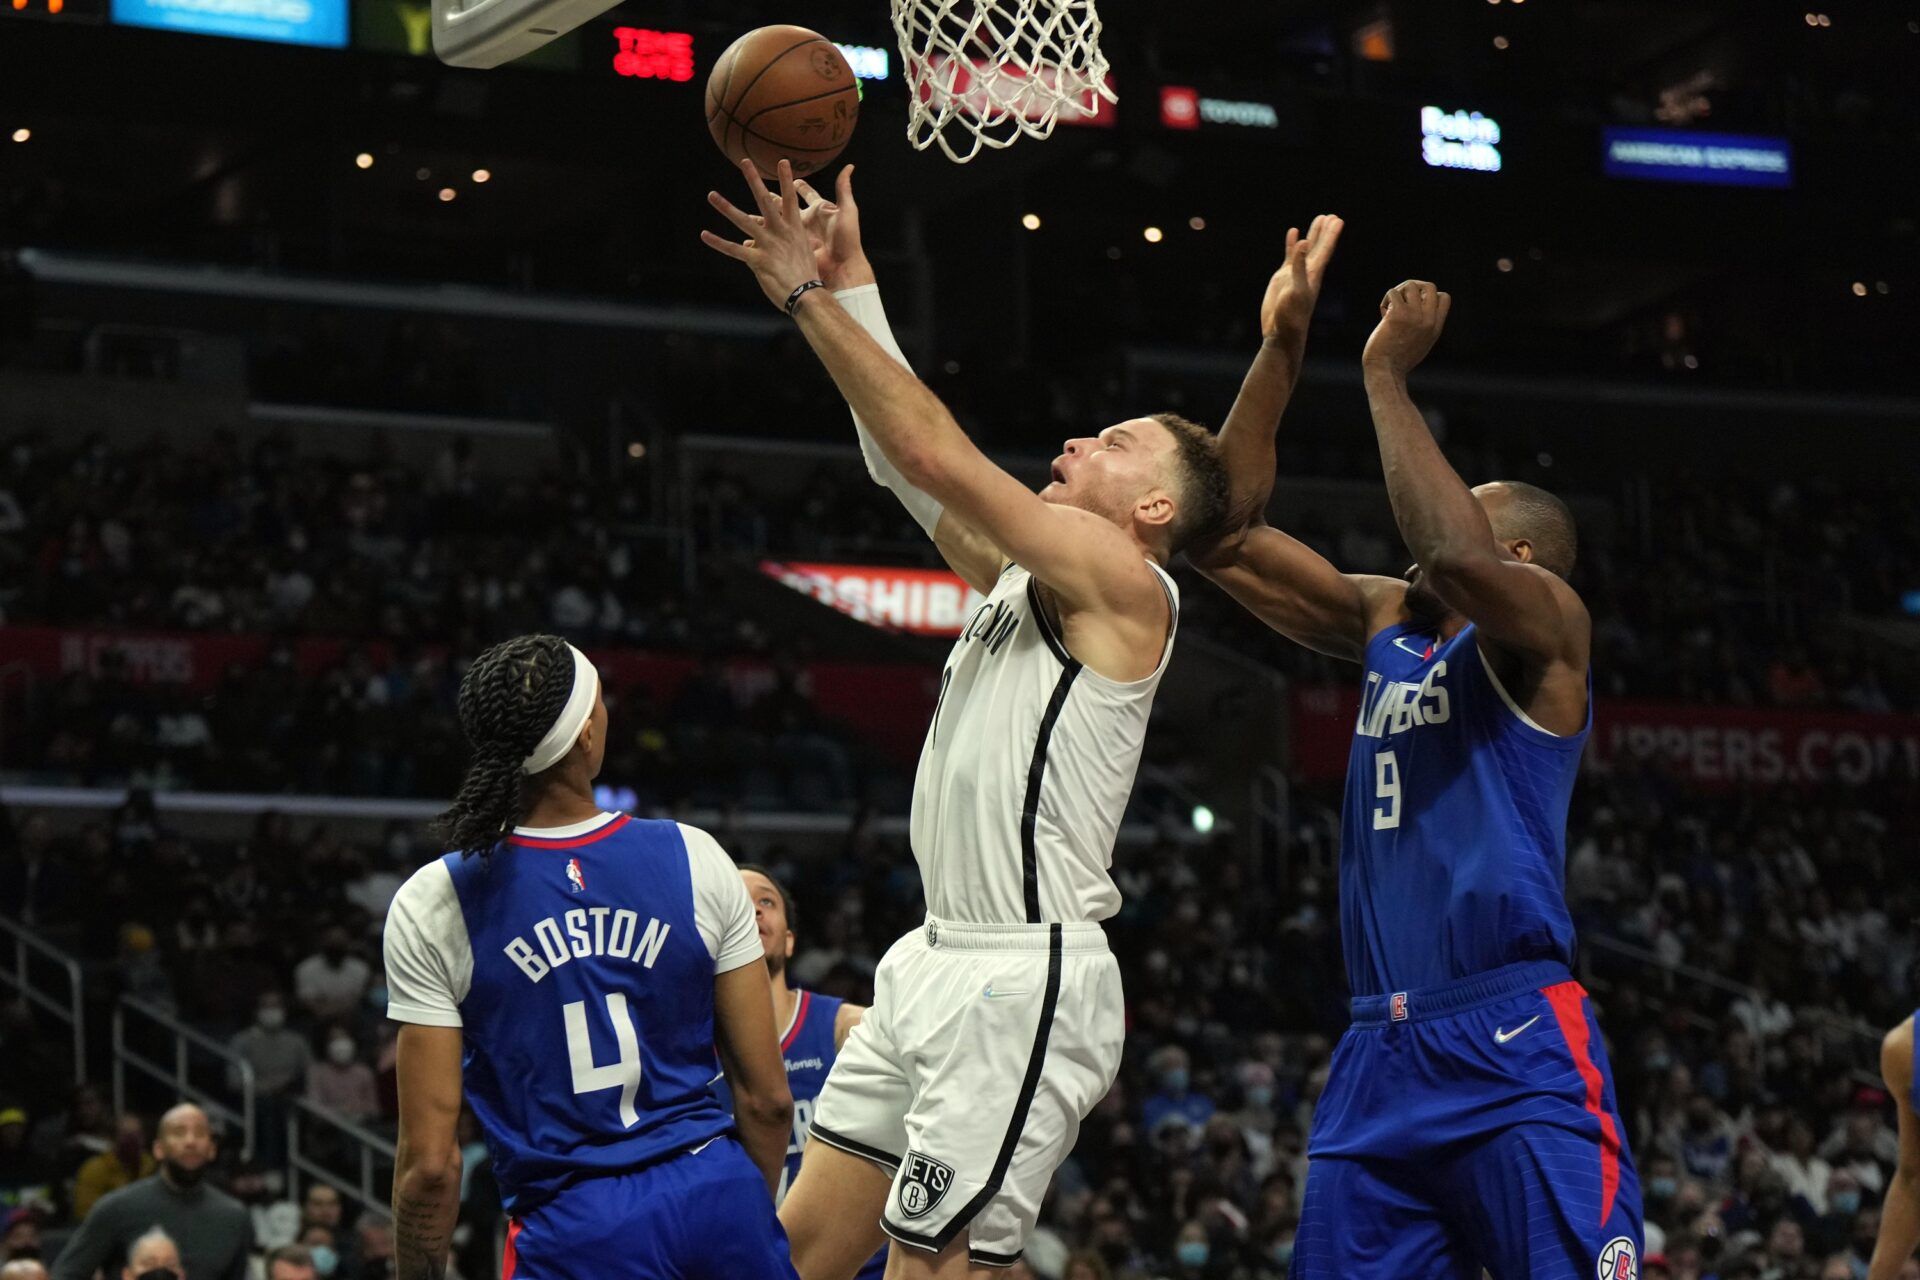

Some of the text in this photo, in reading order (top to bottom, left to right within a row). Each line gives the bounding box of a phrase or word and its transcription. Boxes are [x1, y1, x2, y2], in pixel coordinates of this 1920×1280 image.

[779, 570, 987, 630] OSHIB
[1373, 751, 1401, 831] 9
[503, 907, 671, 984] BOSTON
[562, 992, 642, 1129] 4
[903, 1154, 948, 1192] NETS
[907, 1185, 920, 1209] B
